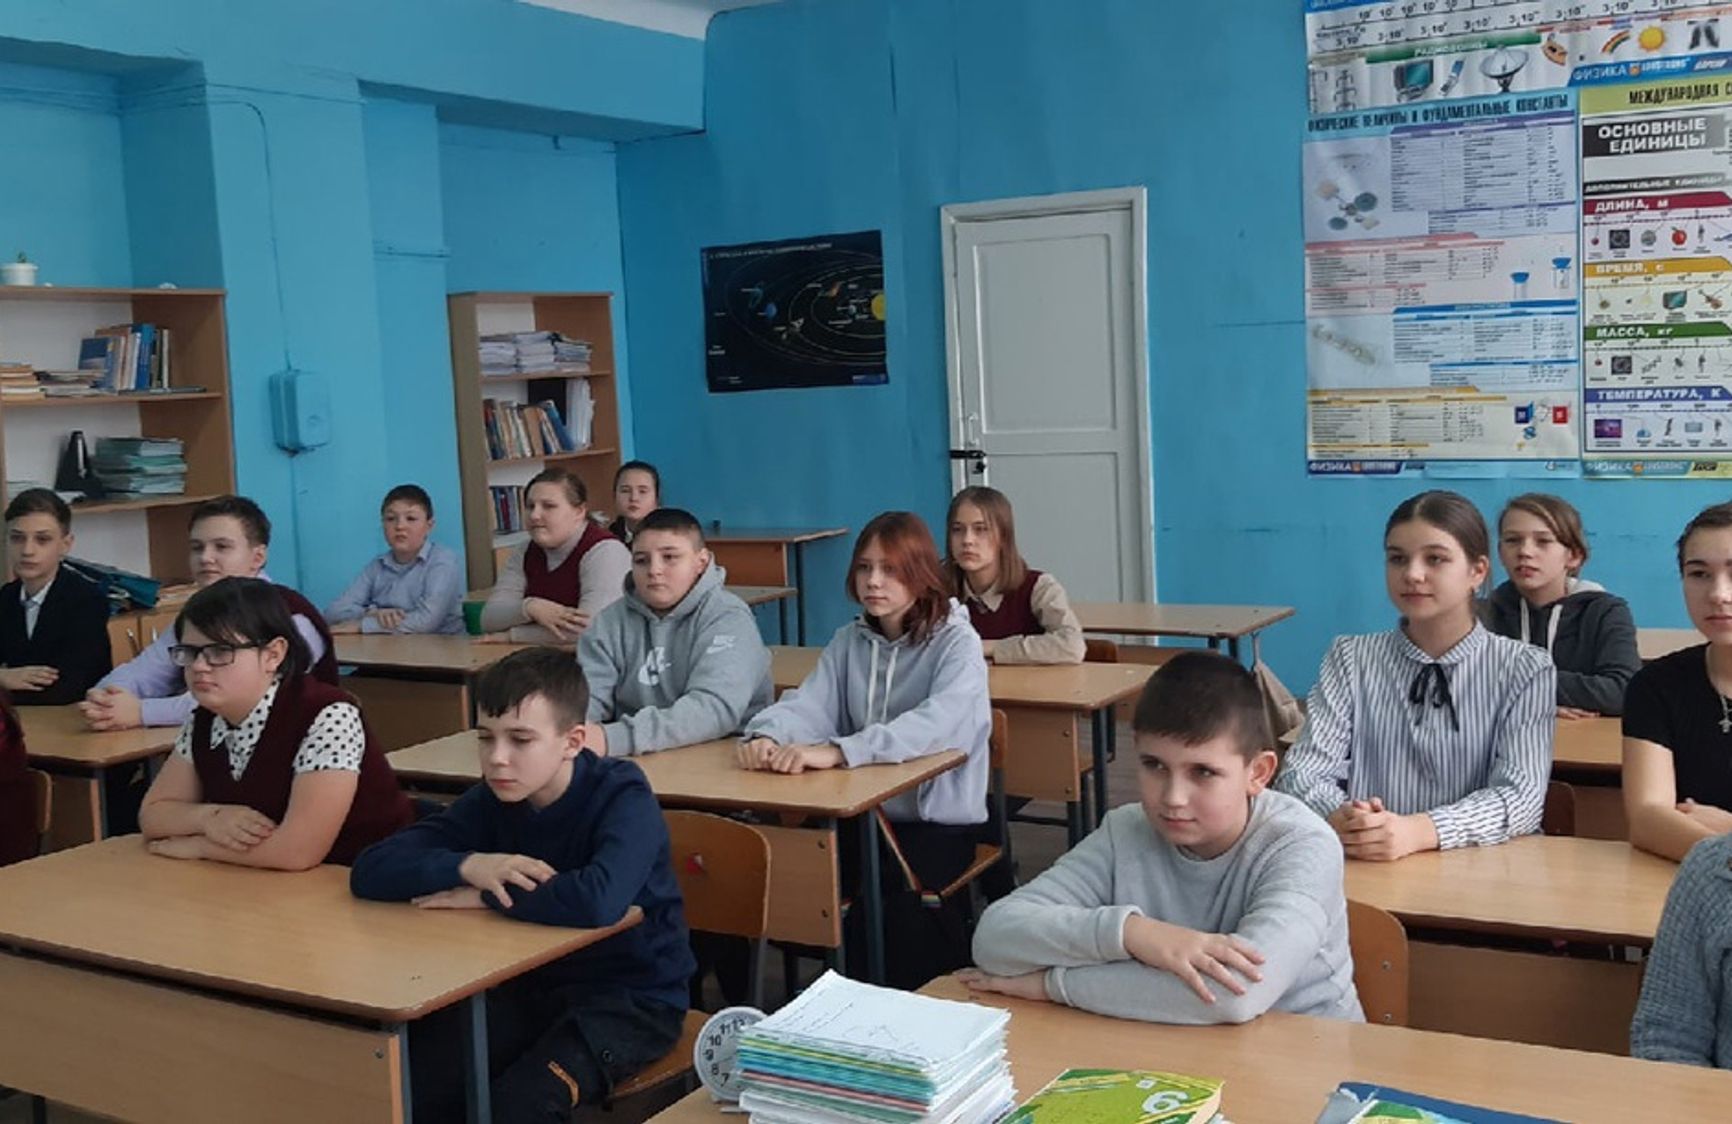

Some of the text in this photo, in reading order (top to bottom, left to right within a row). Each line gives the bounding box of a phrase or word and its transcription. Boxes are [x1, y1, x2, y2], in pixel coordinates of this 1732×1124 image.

[1573, 64, 1627, 81] ФИЗИКА
[1629, 83, 1718, 104] МЕЖДУНАРОДНАЯ
[1598, 117, 1707, 139] ОСНОВНЫЕ
[1609, 133, 1706, 154] ЕДИНИЦЫ
[1595, 198, 1649, 212] ДЛИНА,
[1596, 262, 1648, 274] ВРЕМЯ,
[1596, 327, 1649, 338] МАССА,
[1598, 389, 1703, 401] ТЕМПЕРАТУРА,
[709, 1034, 722, 1046] 10
[705, 1049, 714, 1061] 9
[711, 1063, 720, 1075] 8
[720, 1073, 730, 1087] 7
[1141, 1090, 1189, 1114] 6
